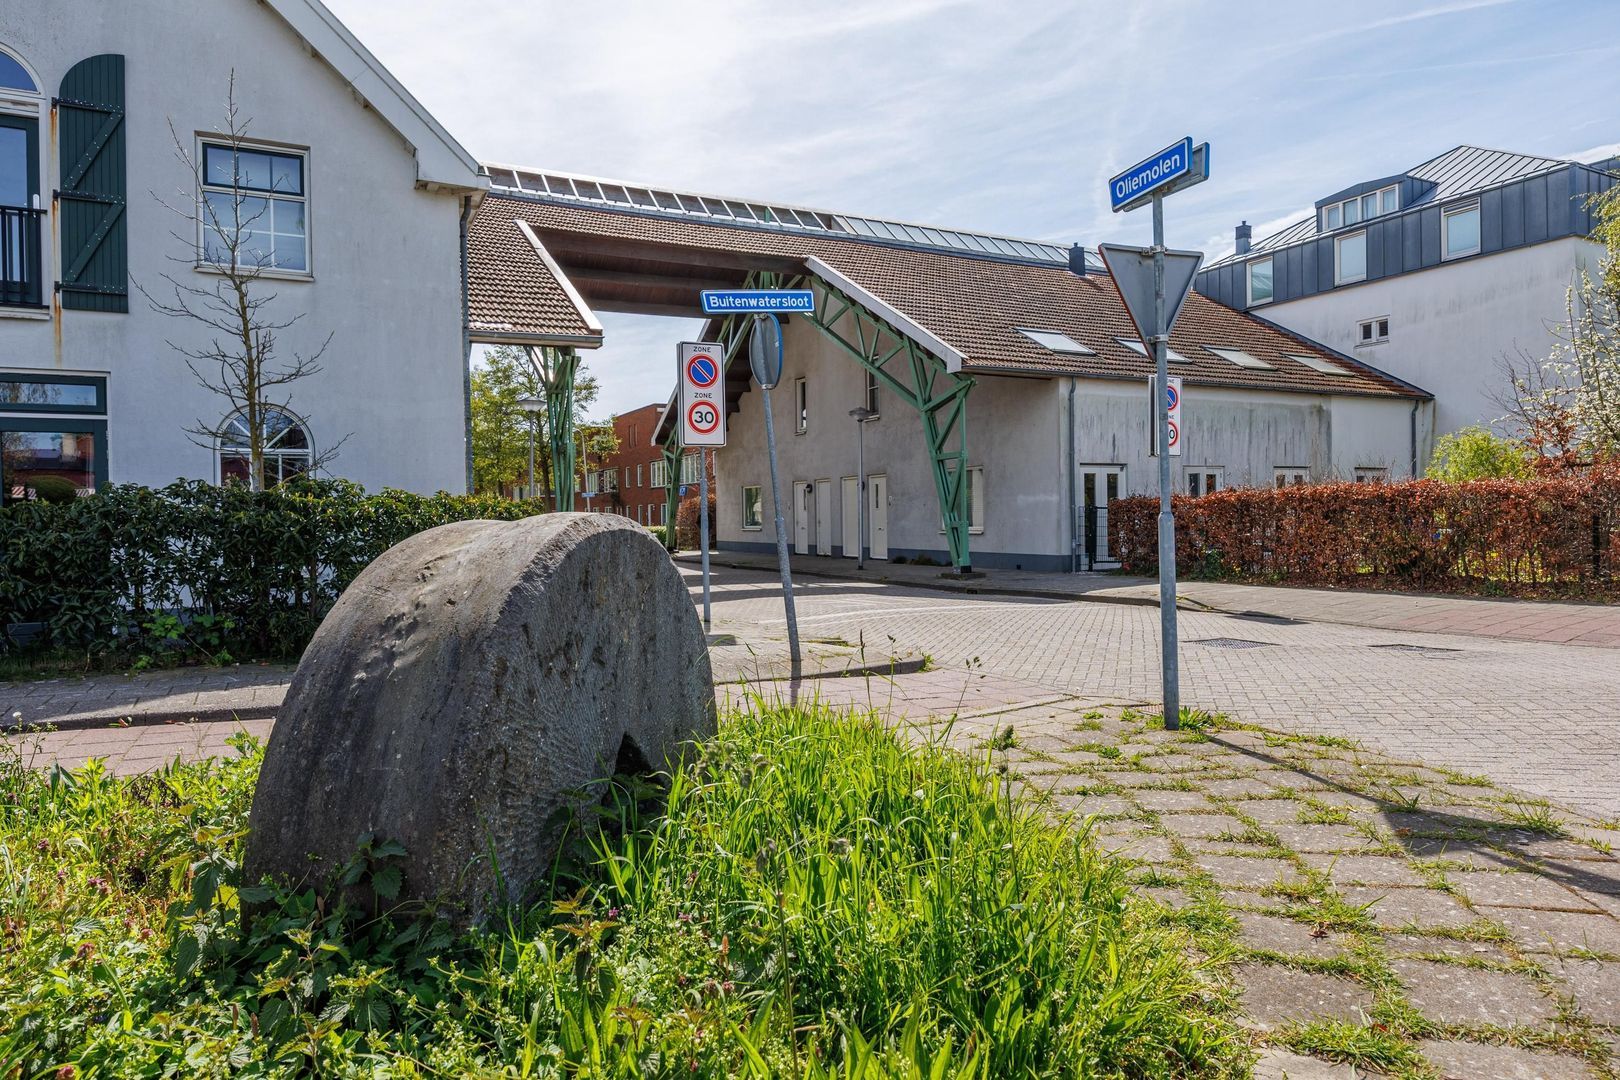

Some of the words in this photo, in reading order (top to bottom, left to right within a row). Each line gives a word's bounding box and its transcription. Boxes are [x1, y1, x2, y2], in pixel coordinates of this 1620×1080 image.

[1116, 154, 1180, 198] Oliemolen
[709, 295, 809, 307] Buitenwatersloot
[694, 411, 714, 424] 30
[1168, 429, 1175, 439] 0
